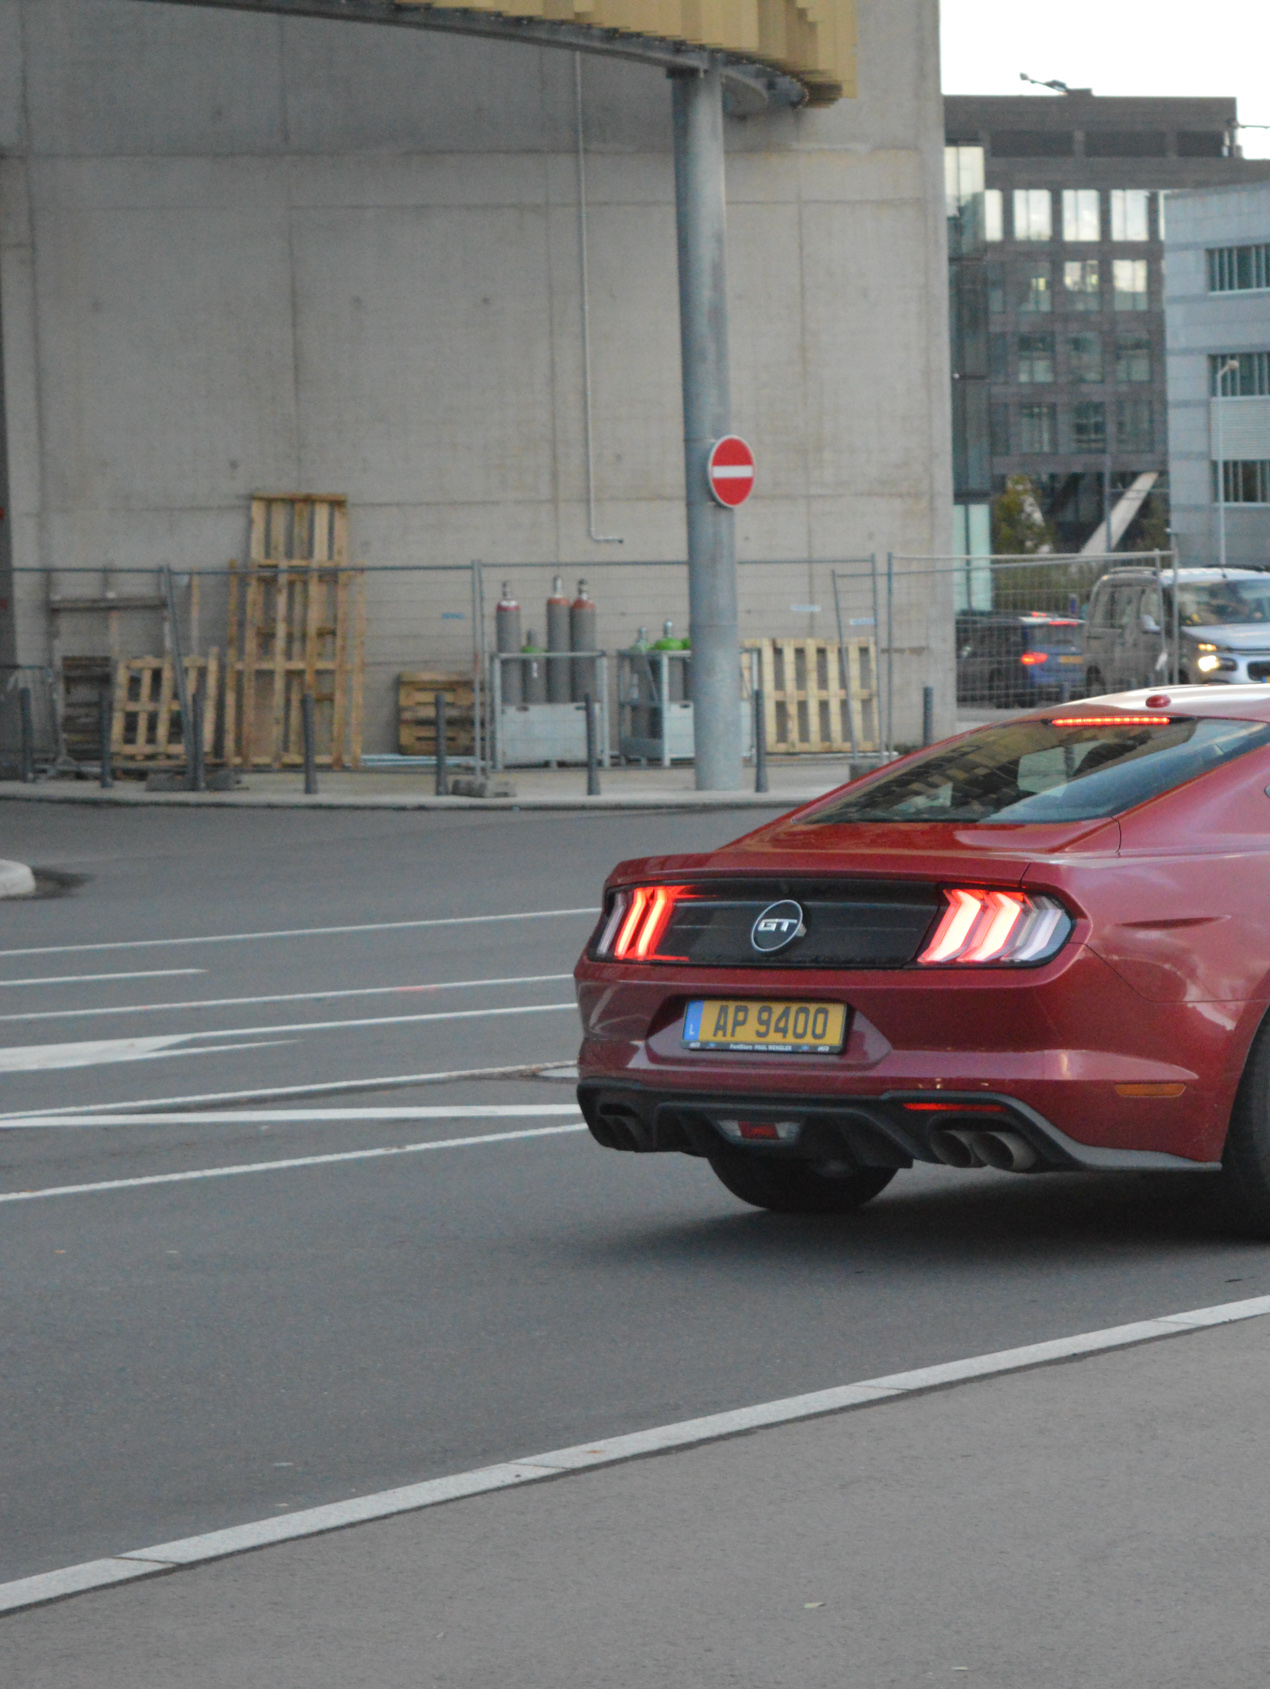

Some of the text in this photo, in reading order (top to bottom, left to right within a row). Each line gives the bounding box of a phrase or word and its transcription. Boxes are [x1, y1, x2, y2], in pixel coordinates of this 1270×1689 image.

[758, 918, 798, 932] GT
[713, 1005, 829, 1039] AP 9400
[689, 1024, 695, 1035] L
